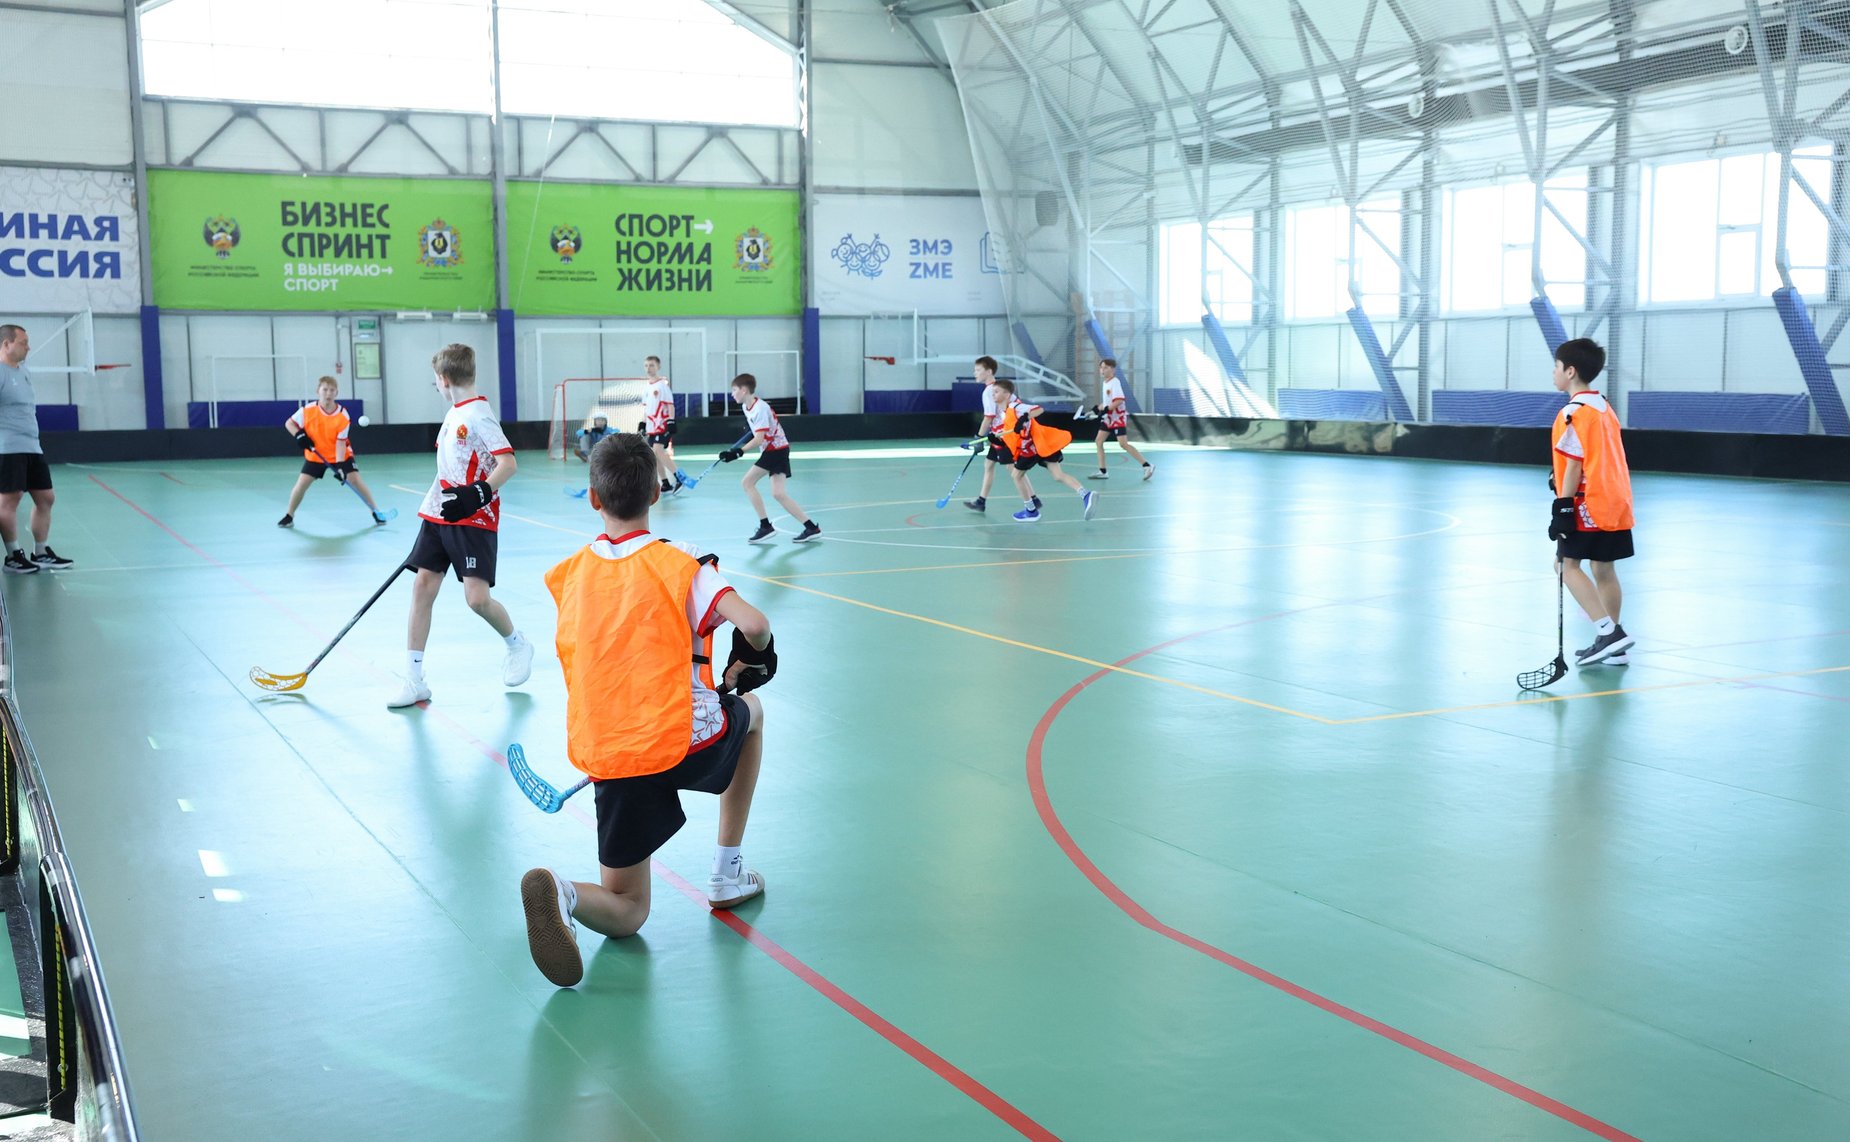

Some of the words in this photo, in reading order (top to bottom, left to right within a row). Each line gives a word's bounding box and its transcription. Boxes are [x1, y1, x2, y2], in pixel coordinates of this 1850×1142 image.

[281, 201, 390, 230] БИЗНЕС
[614, 213, 695, 238] СПОРТ
[281, 232, 391, 260] СПРИНТ
[616, 240, 712, 265] НОРМА
[909, 239, 953, 256] ЗМЭ
[0, 248, 121, 280] ССИЯ
[283, 263, 293, 276] Я
[298, 263, 382, 277] ВЫБИРАЮ
[909, 262, 953, 279] ZME
[283, 278, 339, 292] СПОРТ
[616, 268, 713, 292] ЖИЗНИ
[465, 556, 477, 569] 18
